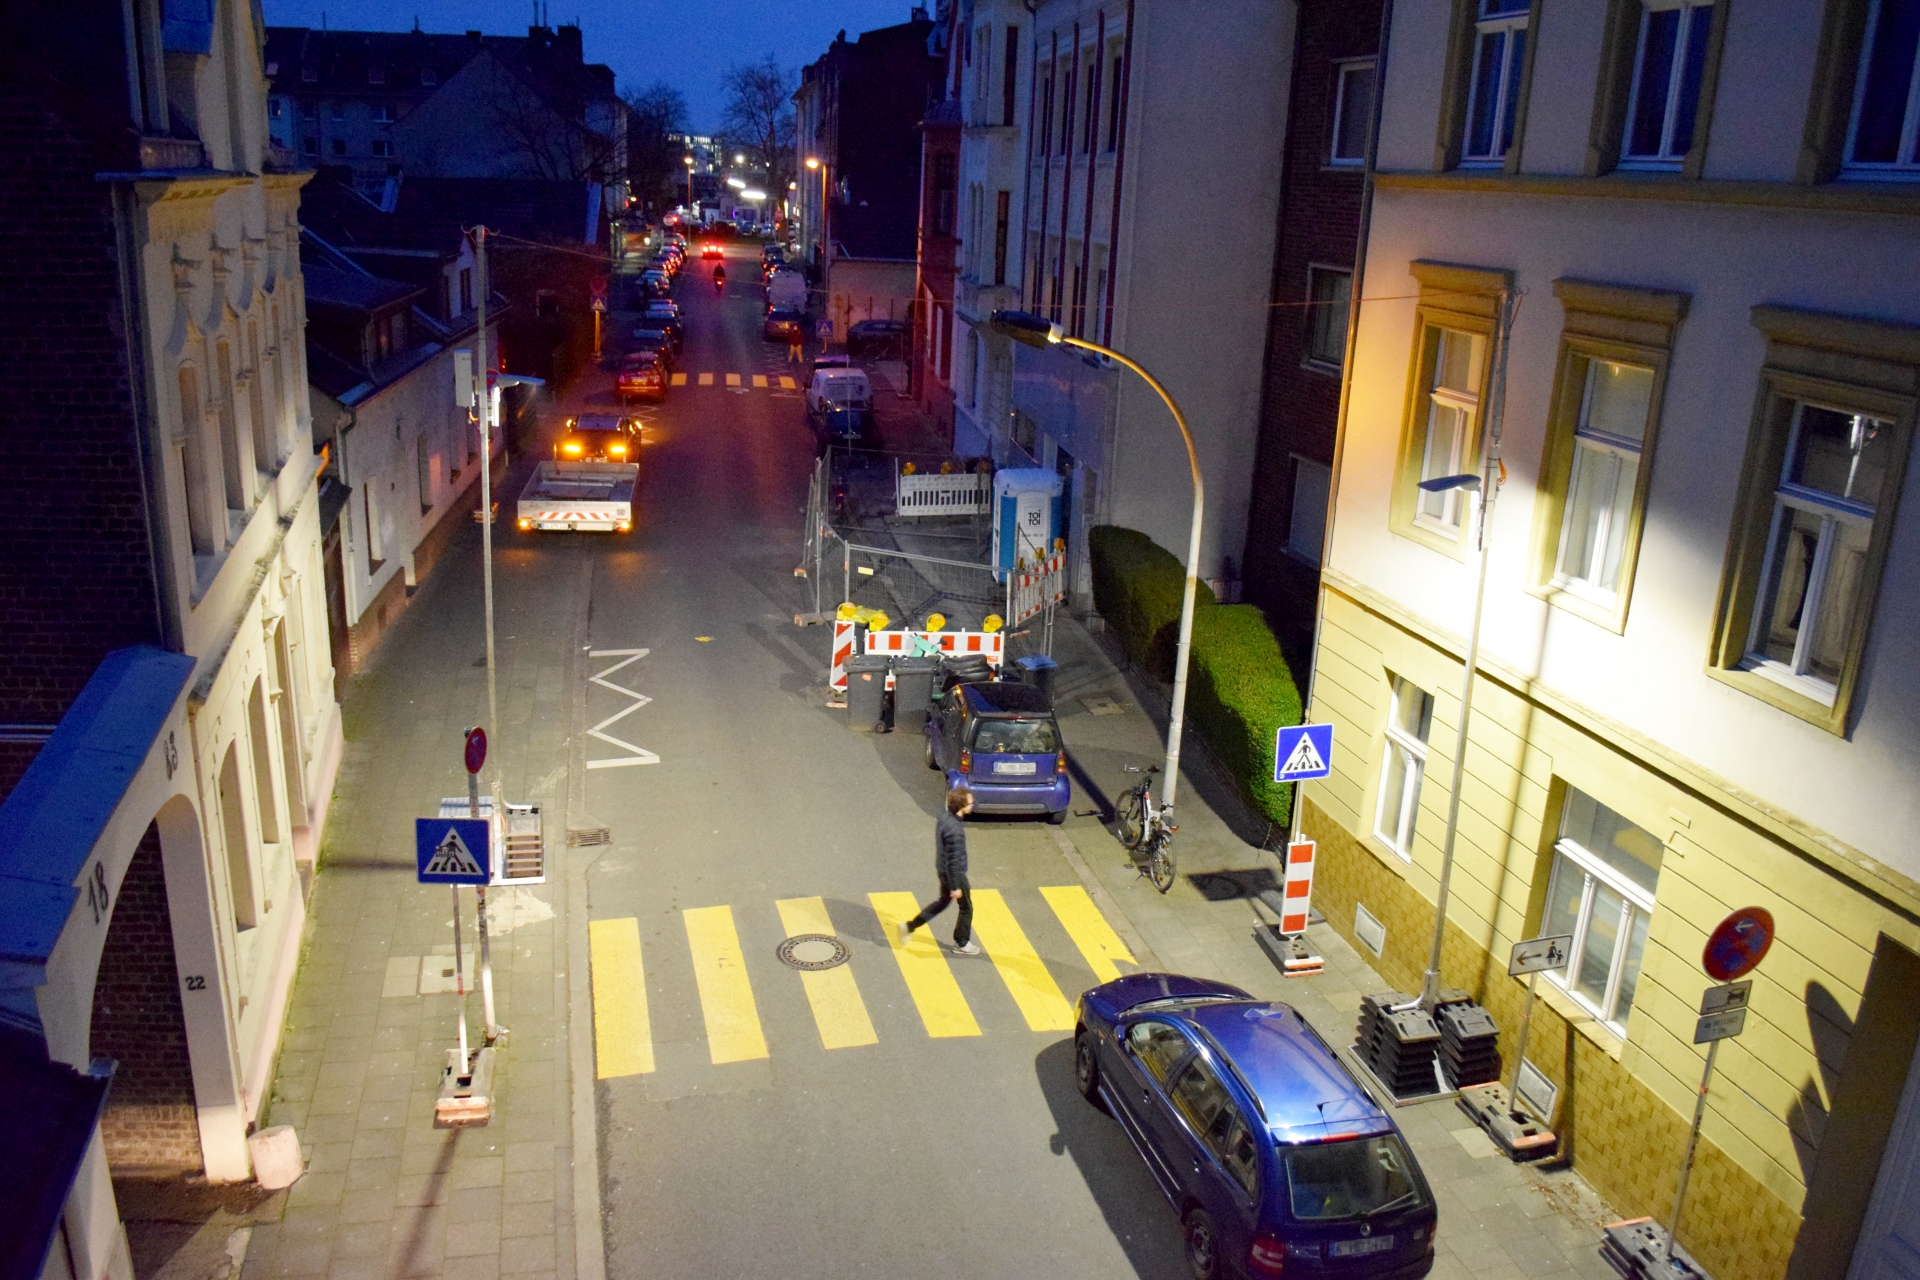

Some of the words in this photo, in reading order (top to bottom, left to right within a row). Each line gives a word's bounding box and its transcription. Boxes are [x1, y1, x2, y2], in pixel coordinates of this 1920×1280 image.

[1028, 509, 1041, 519] TOI
[87, 860, 109, 924] 18
[185, 975, 206, 991] 22
